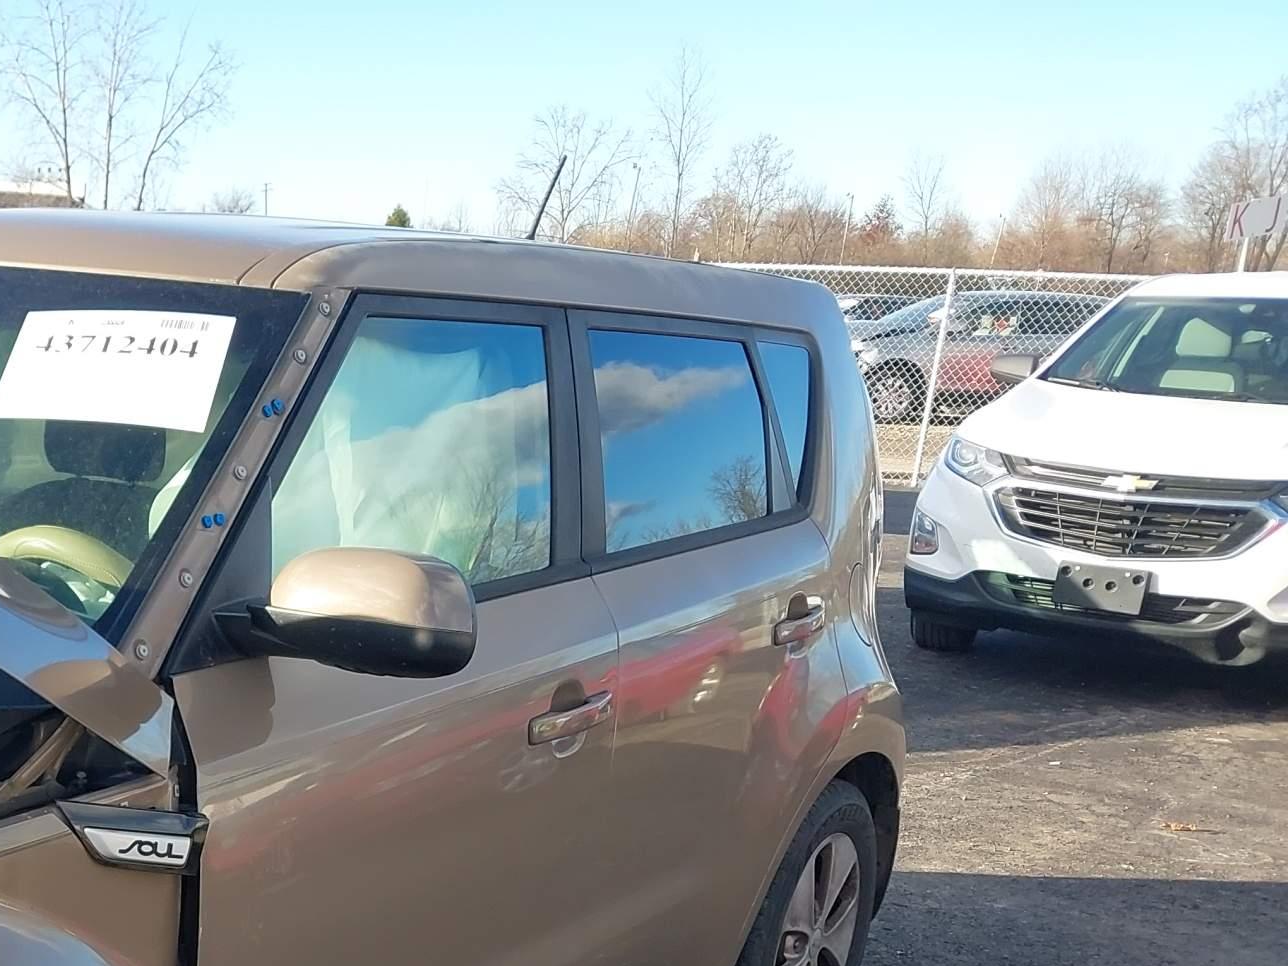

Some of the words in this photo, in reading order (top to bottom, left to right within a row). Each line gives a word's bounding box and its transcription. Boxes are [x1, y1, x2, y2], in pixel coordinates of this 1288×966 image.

[1229, 202, 1250, 240] K
[35, 334, 200, 358] 43712404
[118, 839, 184, 859] SOUL
